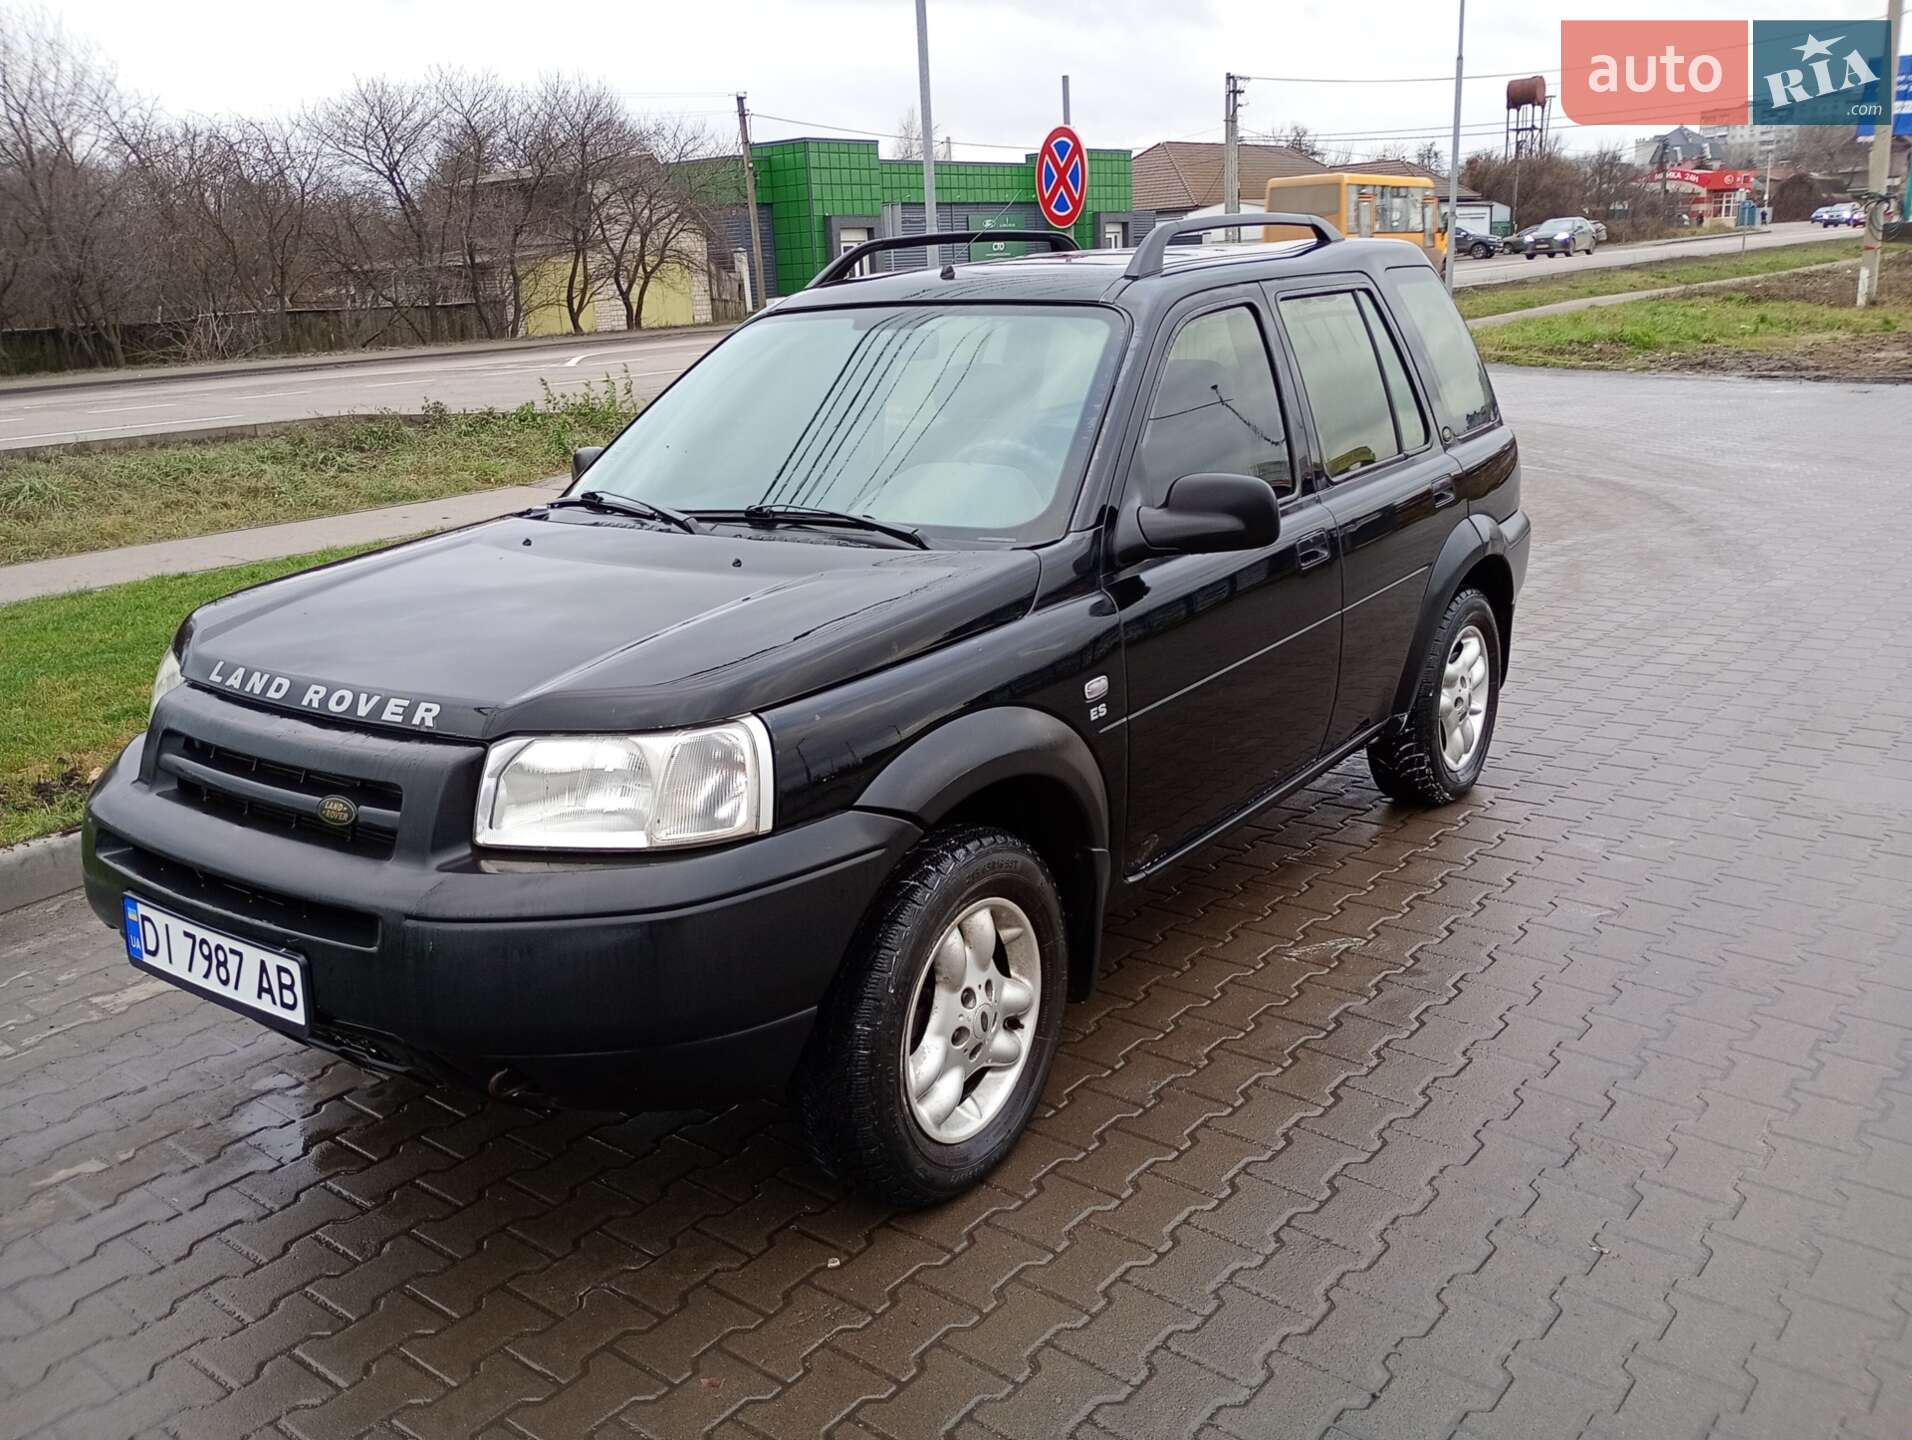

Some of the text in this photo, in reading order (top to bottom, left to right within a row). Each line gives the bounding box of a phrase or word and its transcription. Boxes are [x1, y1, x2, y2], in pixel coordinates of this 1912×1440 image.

[209, 660, 441, 729] LAND ROVER
[1090, 703, 1107, 721] ES
[130, 935, 141, 950] UA
[140, 914, 298, 1011] DI 7987 AB
